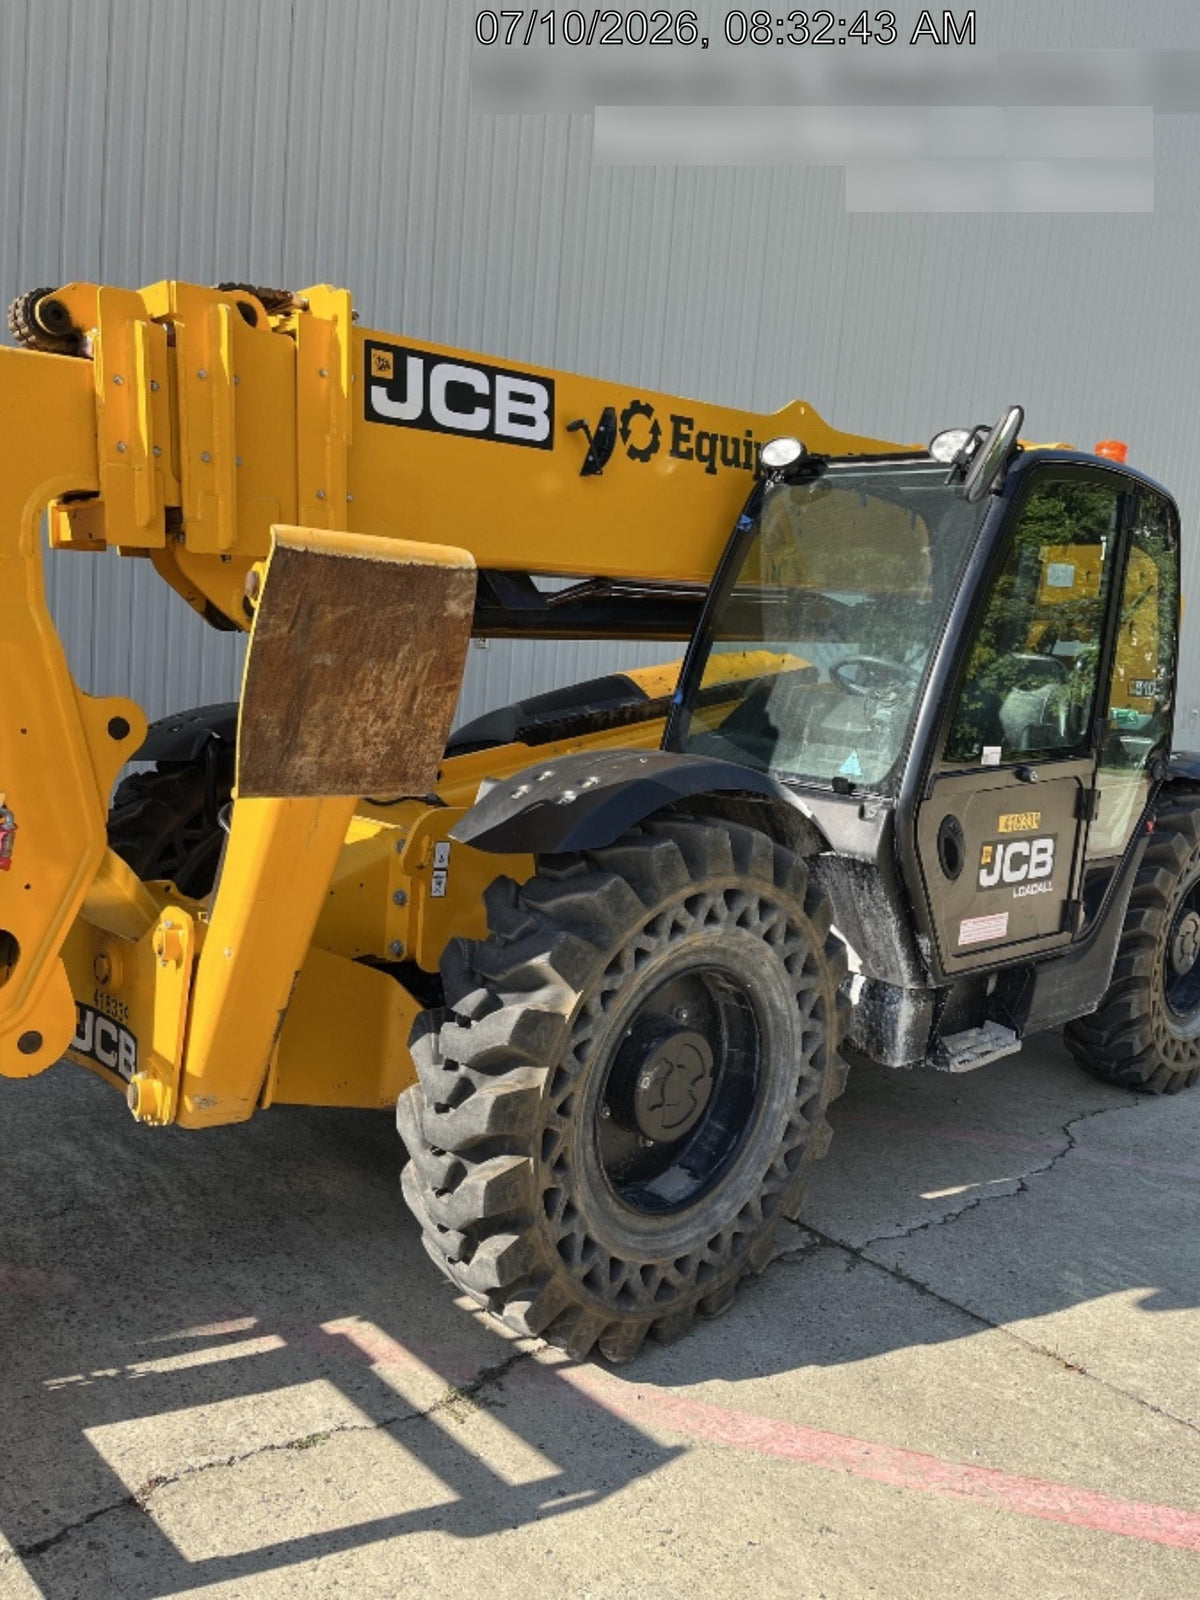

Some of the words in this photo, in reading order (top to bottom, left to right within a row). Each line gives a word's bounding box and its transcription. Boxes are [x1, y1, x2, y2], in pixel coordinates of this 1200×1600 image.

[371, 355, 550, 442] JCB
[979, 838, 1054, 887] JCB
[73, 1010, 137, 1082] JCB
